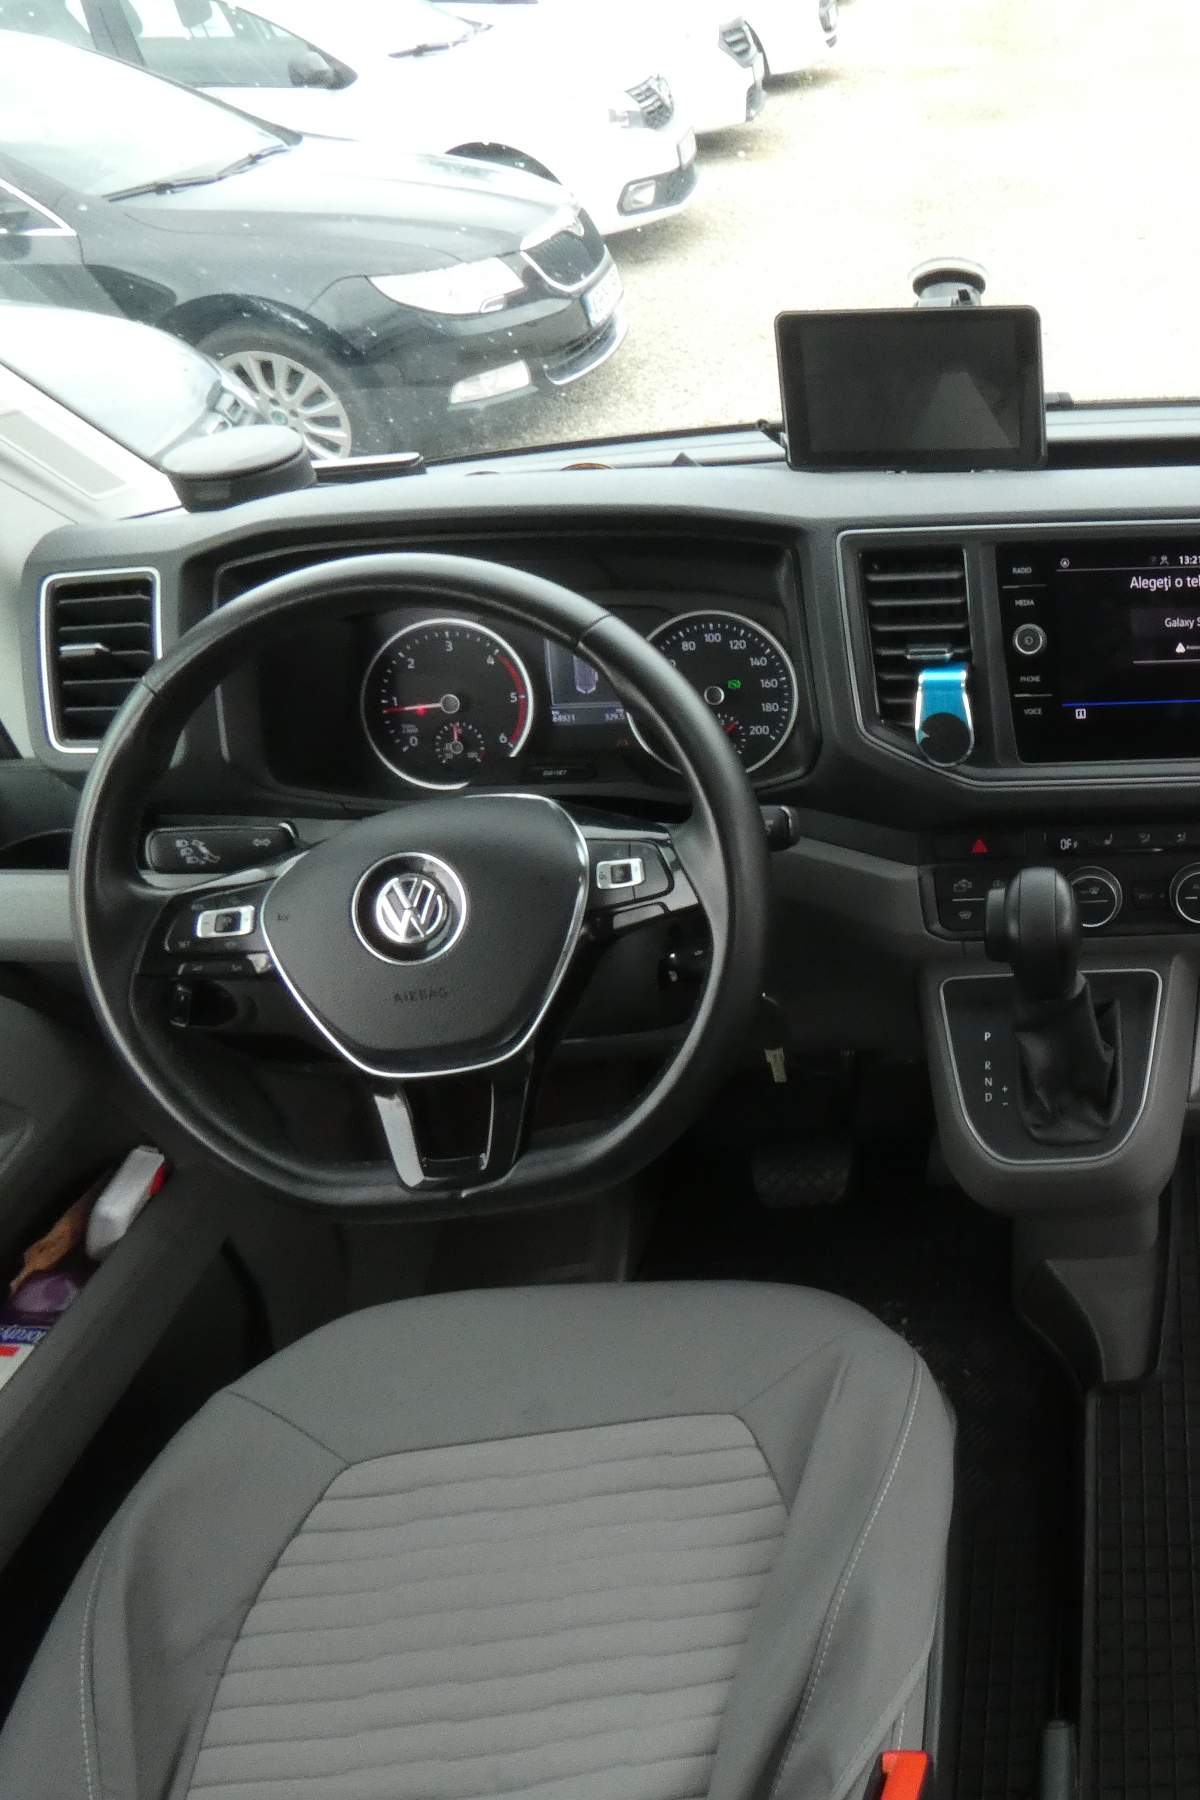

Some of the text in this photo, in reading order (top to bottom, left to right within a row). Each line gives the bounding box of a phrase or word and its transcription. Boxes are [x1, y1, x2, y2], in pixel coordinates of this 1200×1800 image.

[1011, 566, 1033, 575] RADIO
[1174, 577, 1183, 587] o
[1014, 599, 1035, 607] MEDIA
[1164, 616, 1195, 630] Galaxy
[704, 632, 722, 643] 100
[446, 640, 454, 652] 3
[681, 641, 696, 652] 80
[729, 639, 747, 650] 120
[407, 658, 416, 670] 2
[486, 654, 496, 666] 4
[749, 656, 768, 667] 140
[760, 678, 778, 689] 160
[1019, 675, 1041, 683] PHONE
[392, 696, 398, 707] 1
[509, 692, 518, 704] 5
[761, 702, 779, 713] 180
[1023, 707, 1043, 716] VOICE
[749, 725, 770, 736] 200
[409, 735, 418, 748] 0
[498, 732, 508, 744] 6
[984, 1031, 992, 1042] P
[984, 1060, 992, 1070] R
[984, 1077, 993, 1087] N
[984, 1092, 993, 1103] D
